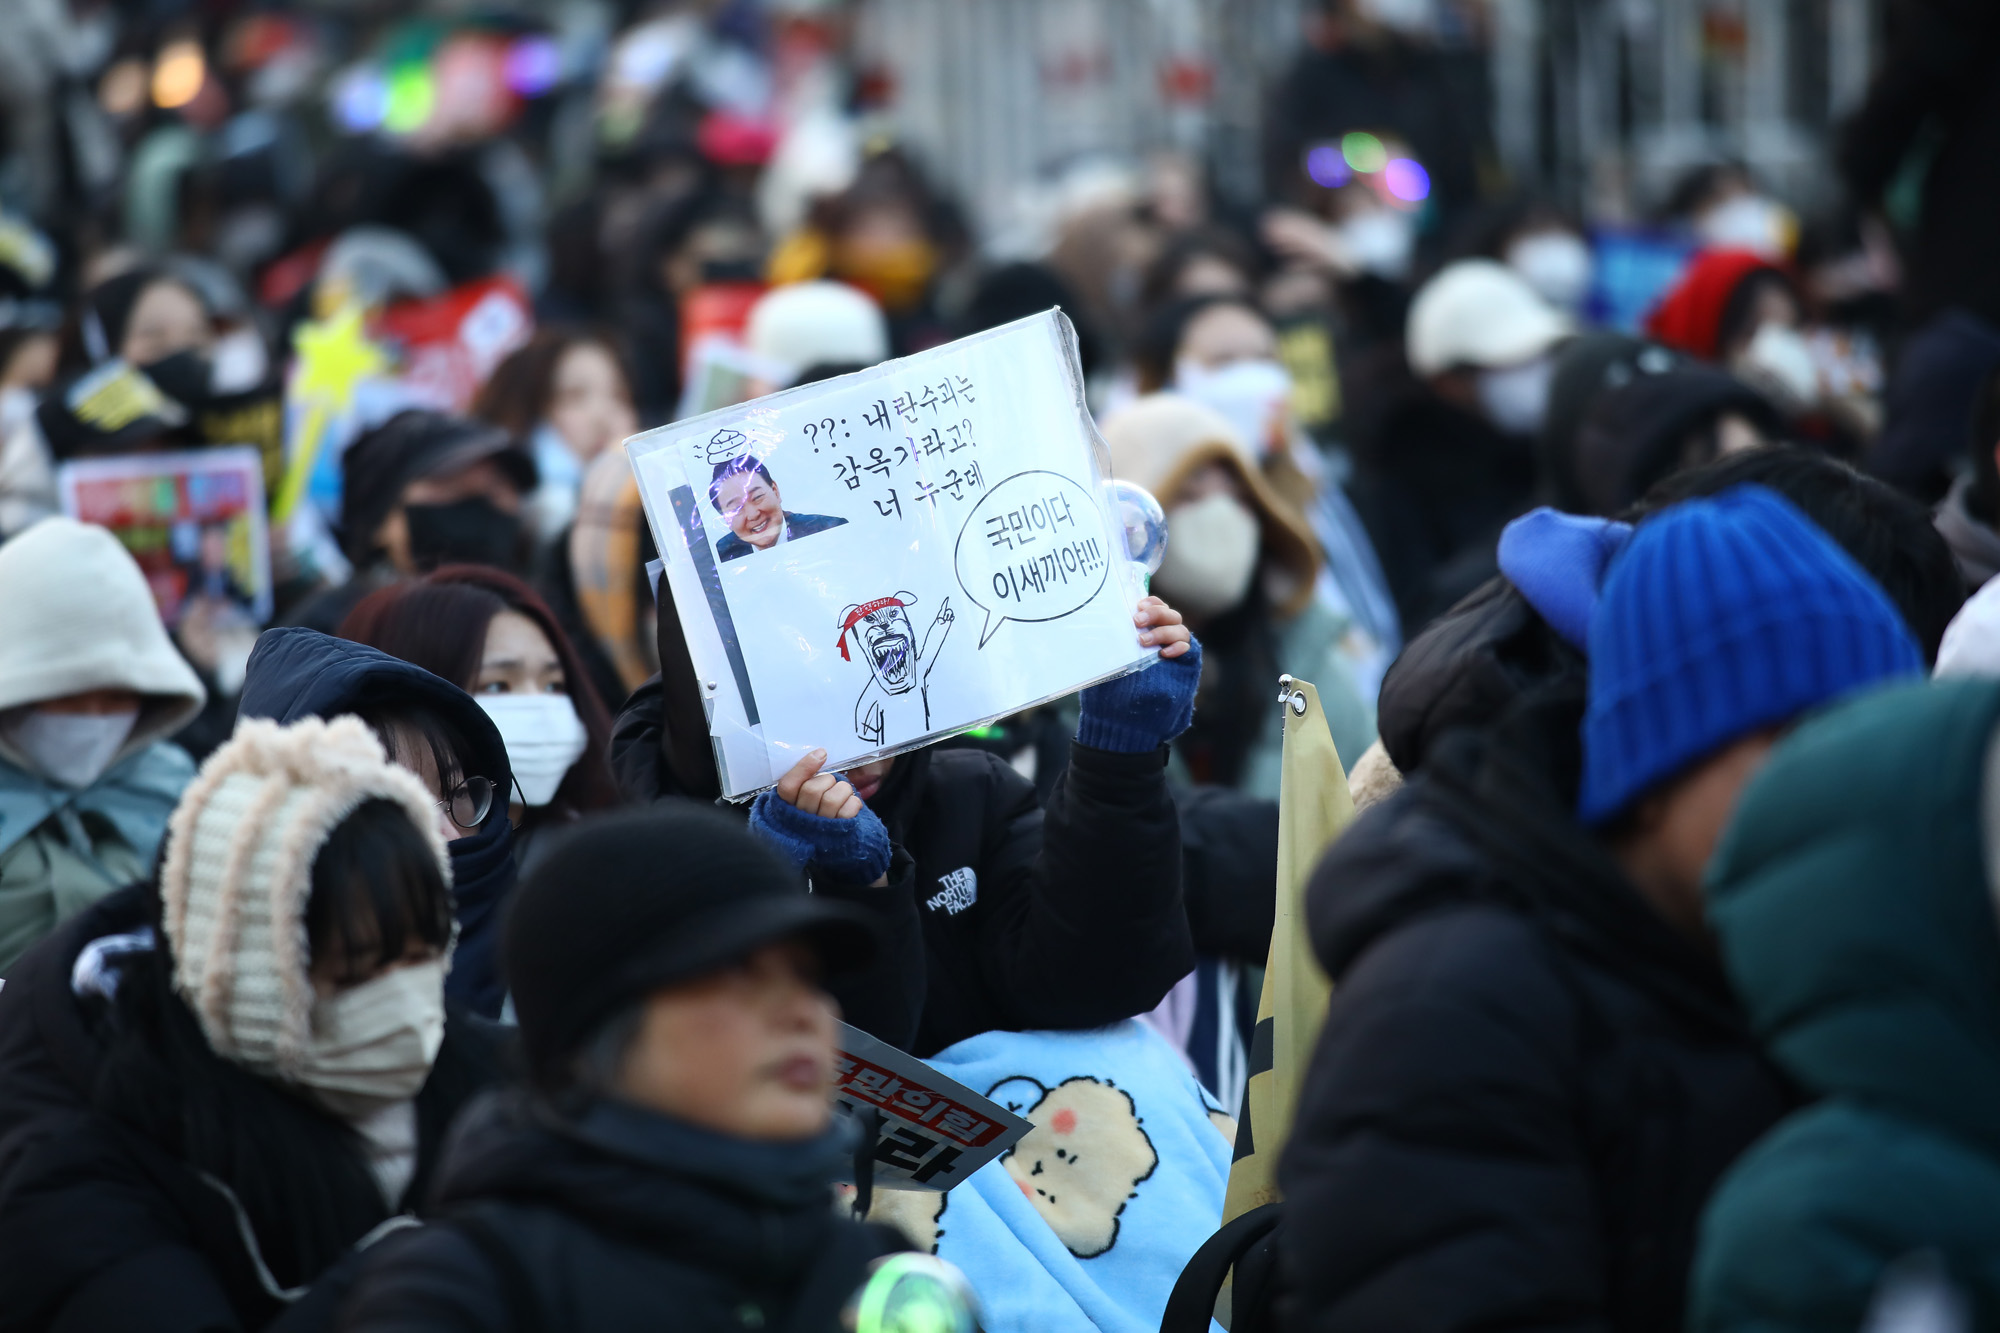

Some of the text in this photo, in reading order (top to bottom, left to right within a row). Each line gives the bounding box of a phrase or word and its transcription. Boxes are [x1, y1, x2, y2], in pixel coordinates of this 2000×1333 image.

[803, 375, 976, 453] ??: 내란수괴는
[873, 460, 986, 520] 너 누군데
[985, 491, 1075, 550] 국민이다
[992, 537, 1104, 602] 이새끼야!!!
[926, 880, 970, 911] NORTH
[938, 869, 966, 889] THE
[946, 893, 974, 915] FACE
